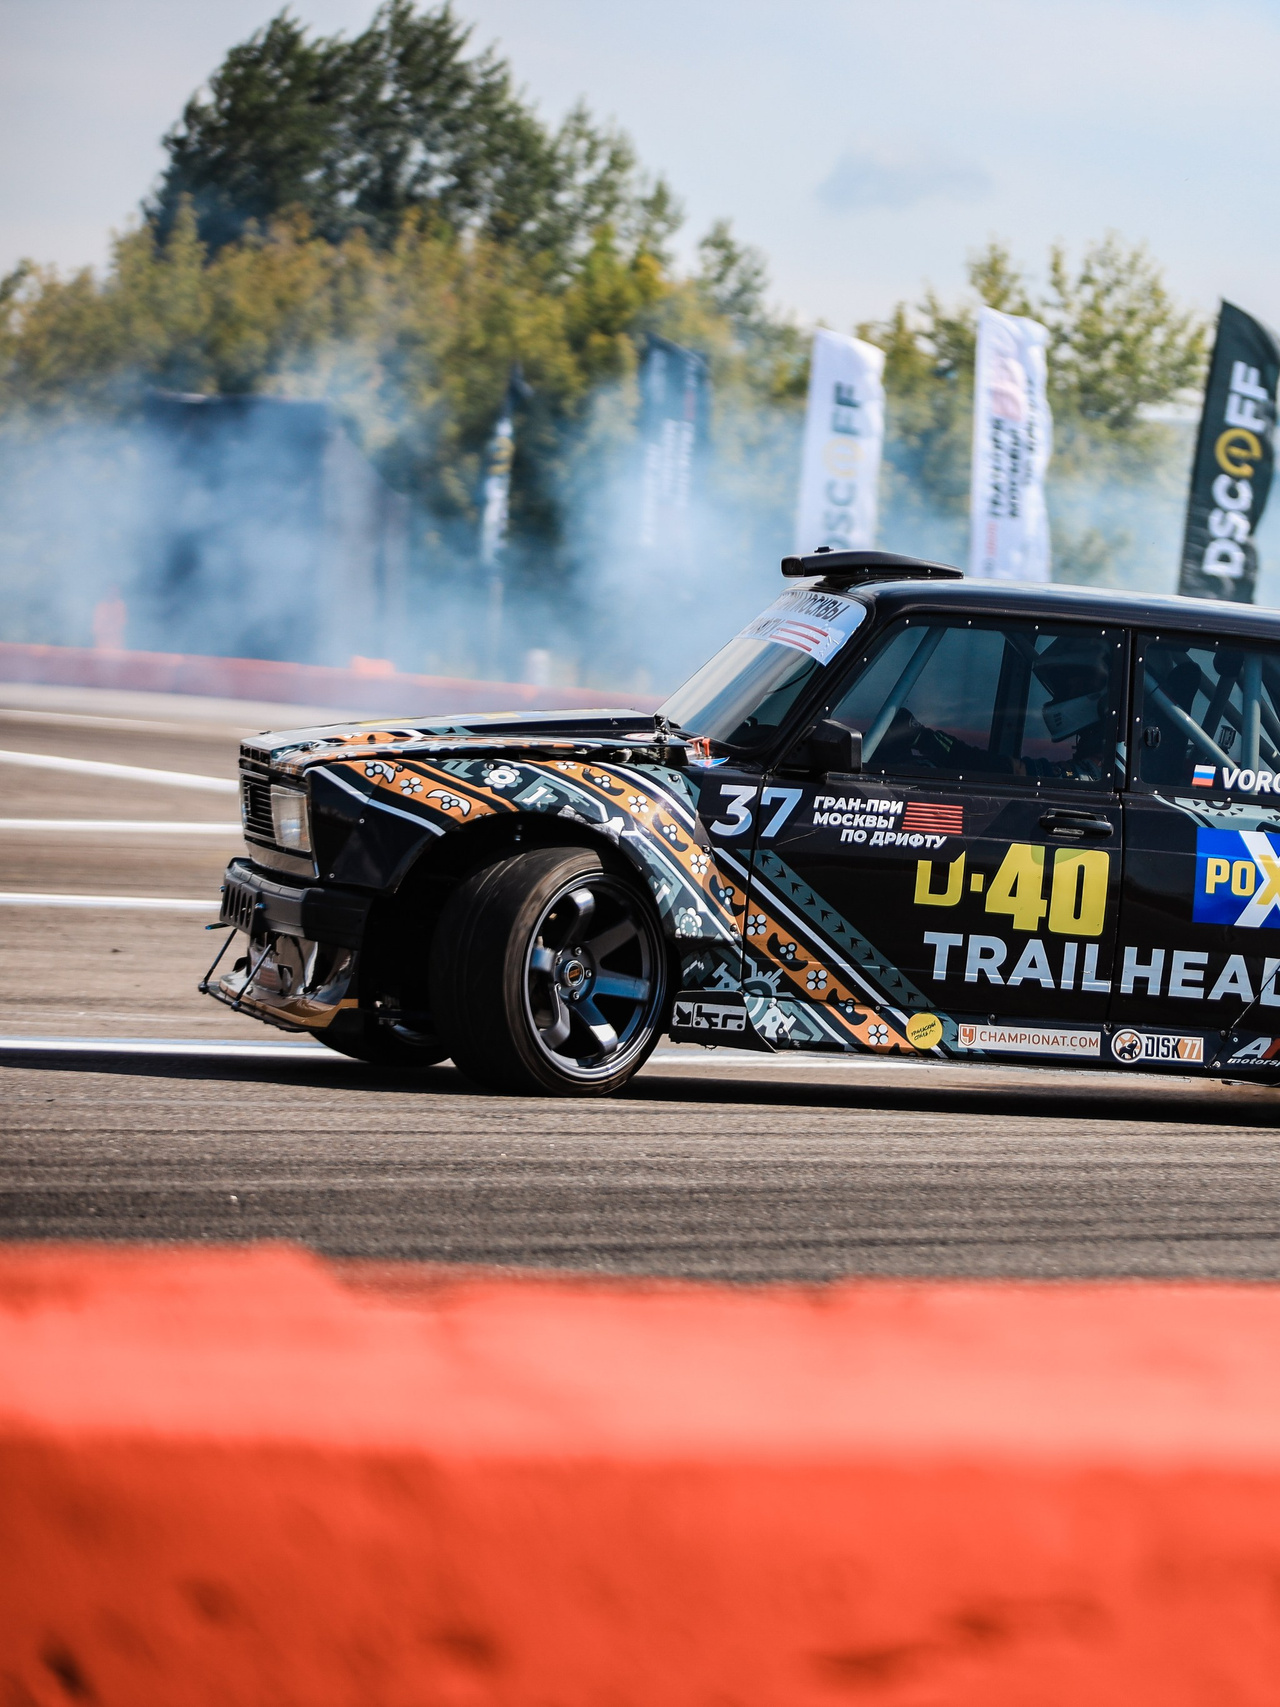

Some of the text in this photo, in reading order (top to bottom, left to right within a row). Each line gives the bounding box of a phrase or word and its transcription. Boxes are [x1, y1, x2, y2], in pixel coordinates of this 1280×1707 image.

[709, 783, 804, 838] 37
[812, 795, 904, 814] ГРАН-ПРИ
[812, 811, 895, 830] МОСКВЫ
[840, 828, 948, 850] ПО ДРИФТУ
[978, 1030, 1100, 1049] CHAMPIONAT.COM
